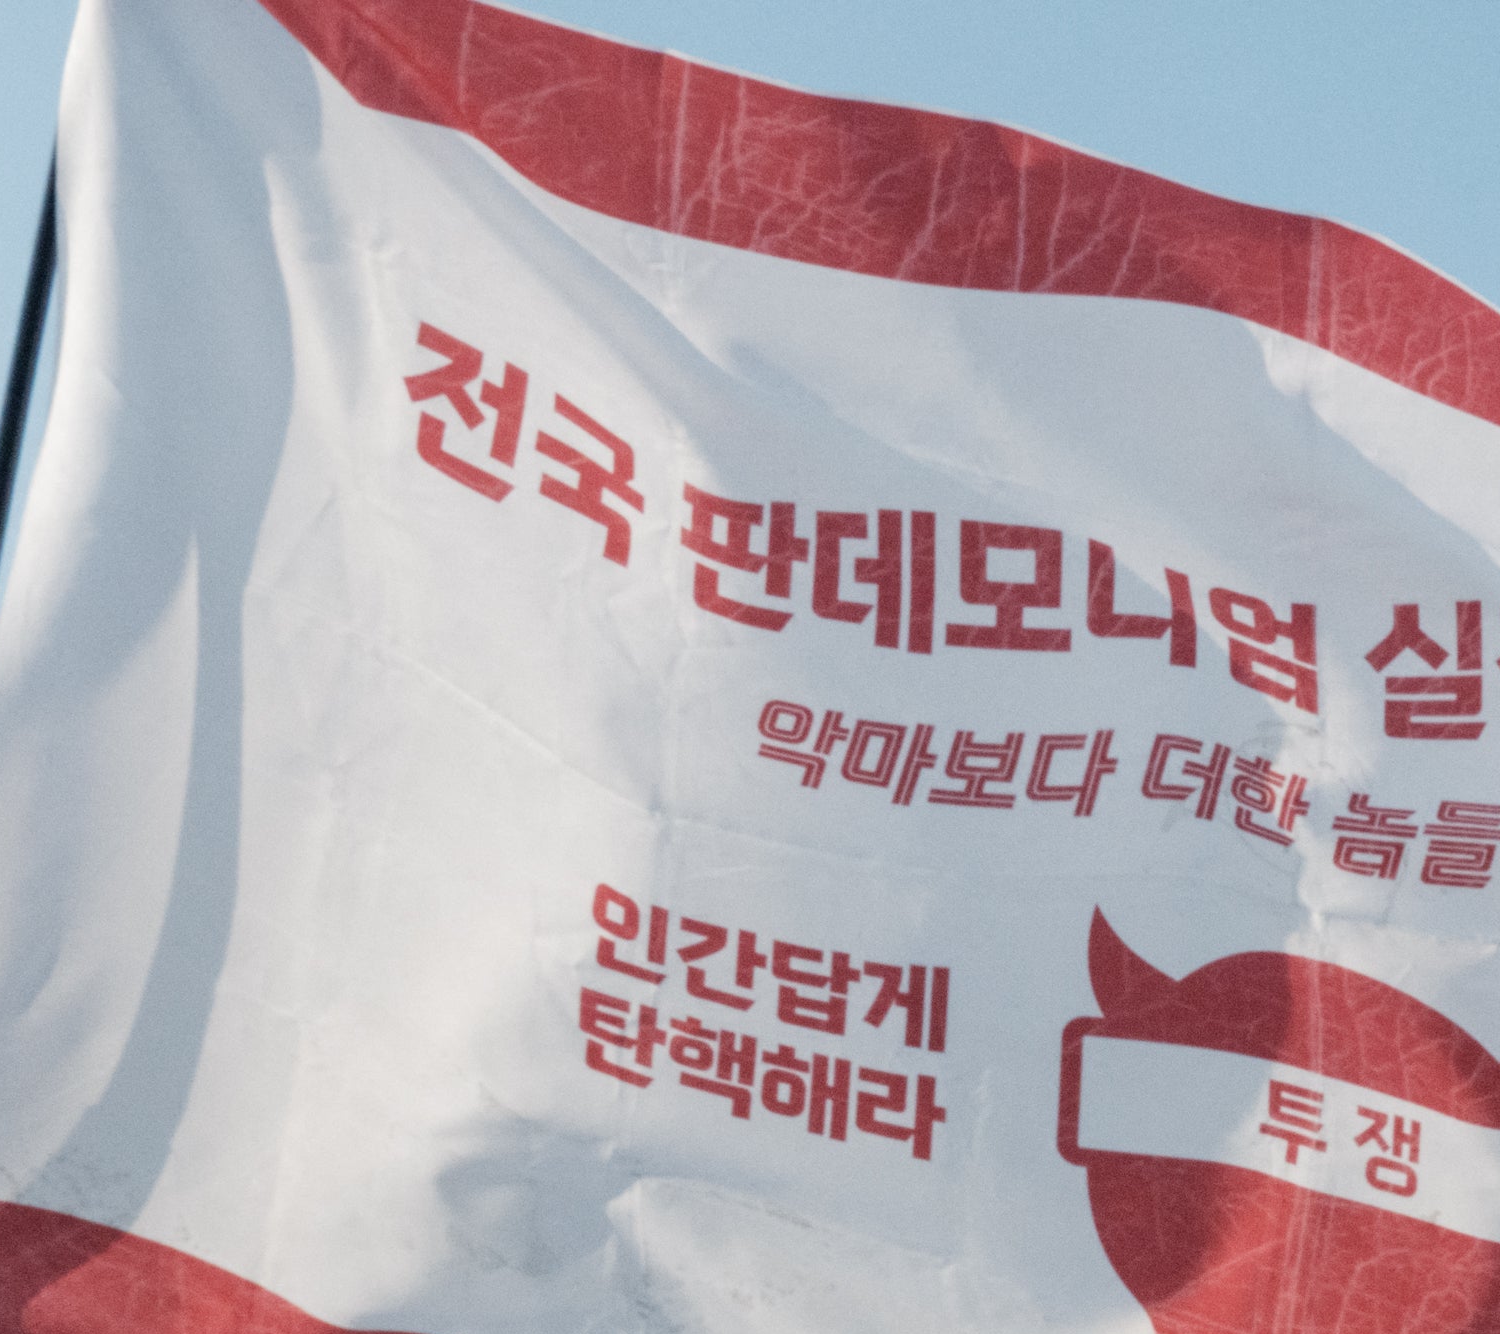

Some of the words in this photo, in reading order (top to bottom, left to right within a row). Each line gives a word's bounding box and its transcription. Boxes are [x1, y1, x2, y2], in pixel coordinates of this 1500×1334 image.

[403, 320, 645, 568] 전국
[679, 482, 1319, 715] 판데모니엄
[756, 698, 1118, 817] 악마보다
[1141, 733, 1309, 847] 더한
[591, 882, 949, 1054] 인간답게
[577, 986, 947, 1160] 탄핵해라
